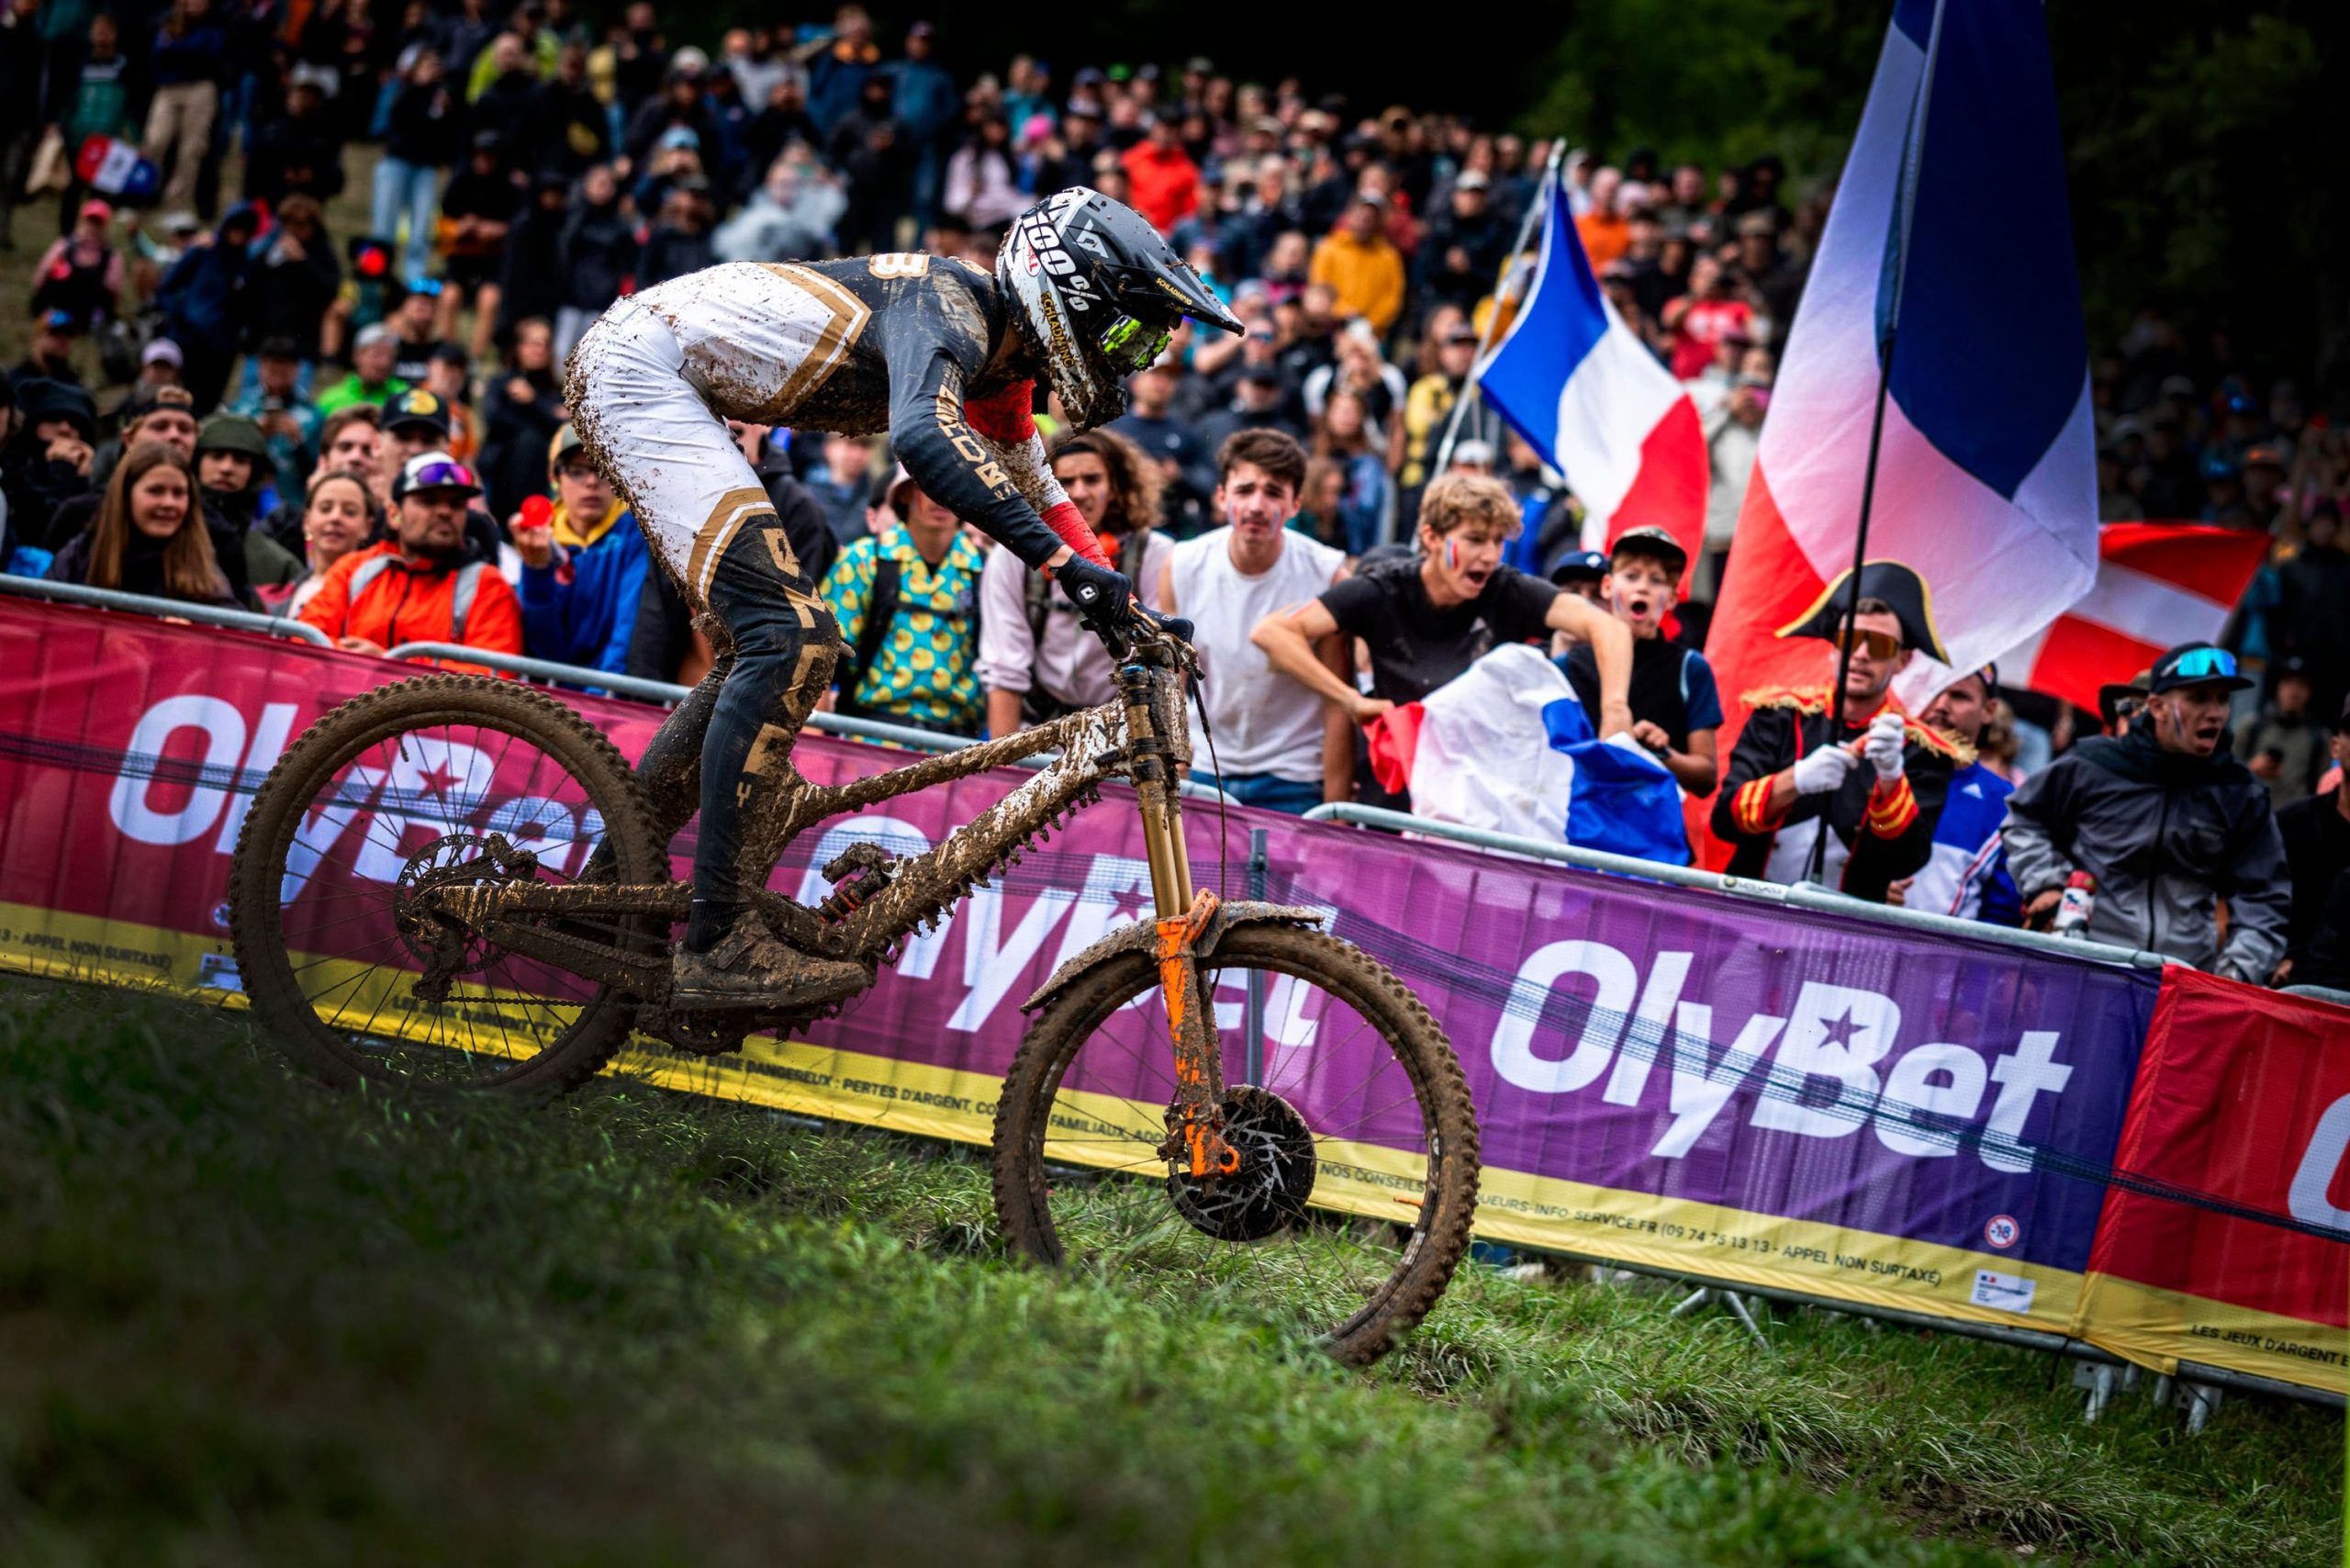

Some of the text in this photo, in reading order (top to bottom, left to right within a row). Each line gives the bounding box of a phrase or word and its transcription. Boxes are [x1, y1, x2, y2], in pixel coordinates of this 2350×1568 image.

[1022, 210, 1102, 312] 100%
[1156, 277, 1193, 306] SCHLADMING
[1490, 938, 2075, 1175] OlyBet
[745, 1058, 833, 1087] DANGEREUX
[842, 1076, 899, 1100] PERTES
[901, 1088, 973, 1114] D'ARGENT,
[975, 1100, 999, 1117] CO
[1321, 1163, 1351, 1179] NOS
[1354, 1168, 1426, 1194] CONSEILS
[1660, 1219, 1684, 1238] (09
[1688, 1227, 1707, 1243] 74
[1730, 1236, 1748, 1249] 13
[1752, 1238, 1771, 1252] 13
[1783, 1244, 1830, 1266] APPEL
[1833, 1254, 1866, 1271] NON
[2191, 1324, 2221, 1339] LES
[2221, 1330, 2263, 1349] JEUX
[2264, 1338, 2340, 1365] D'ARGENT
